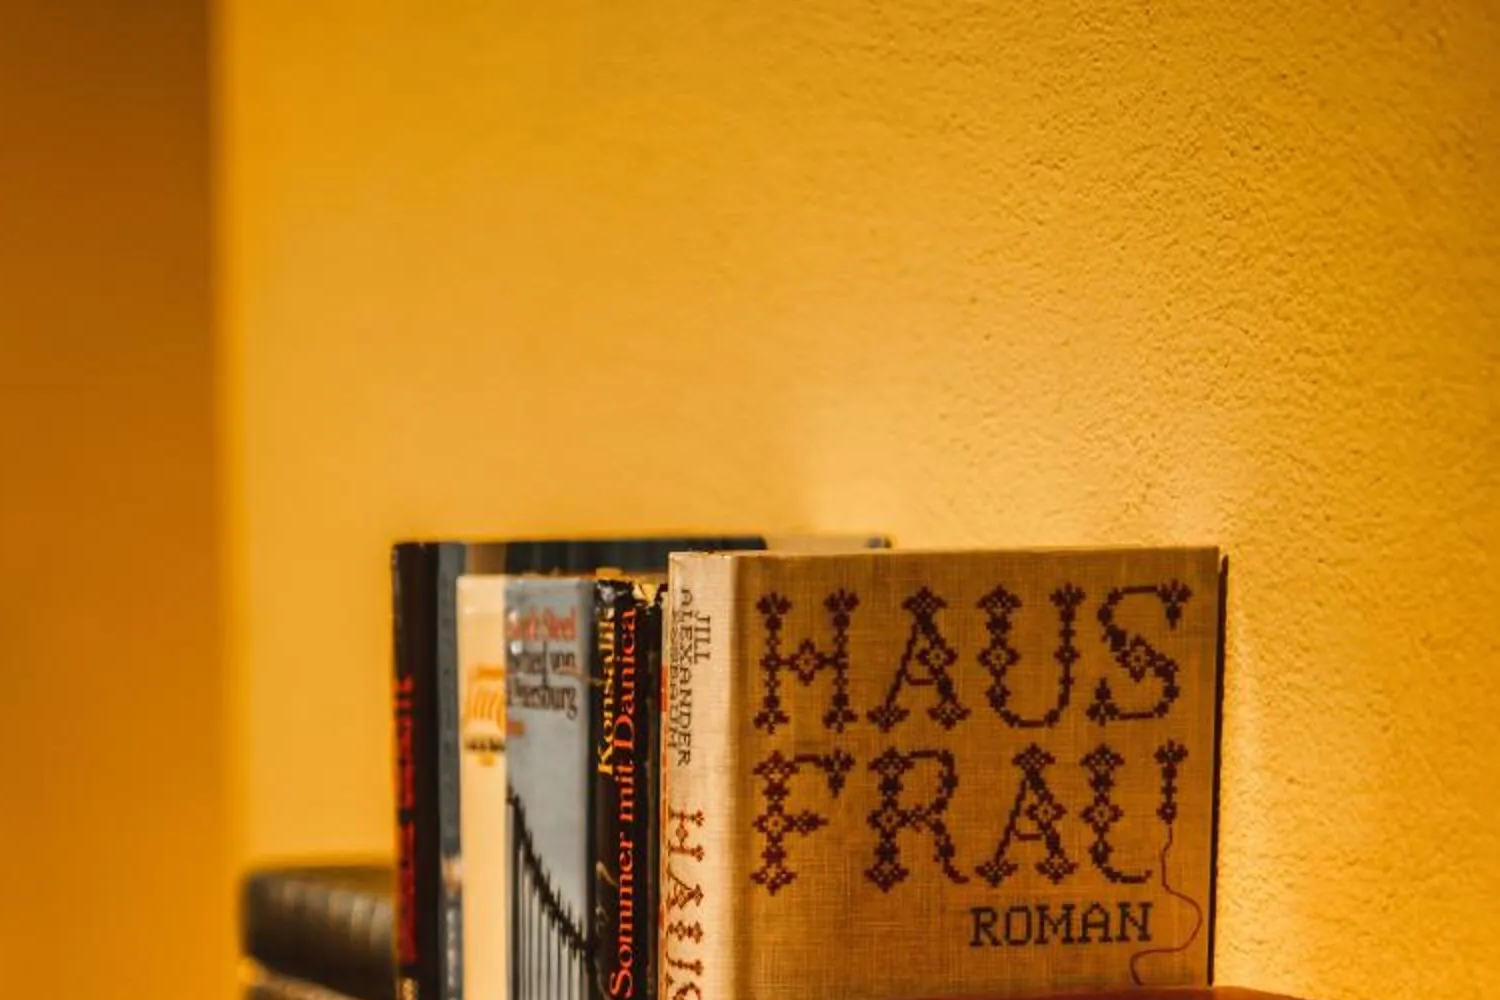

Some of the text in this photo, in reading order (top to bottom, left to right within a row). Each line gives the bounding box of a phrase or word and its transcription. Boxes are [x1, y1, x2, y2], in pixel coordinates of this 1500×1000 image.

[613, 608, 637, 749] Danica
[677, 588, 694, 768] ALEXANDER
[693, 611, 712, 665] JILL
[753, 578, 1192, 734] HAUS
[615, 760, 636, 823] mit
[751, 739, 1188, 895] FRAU
[610, 831, 635, 998] Sommer
[969, 902, 1152, 949] ROMAN
